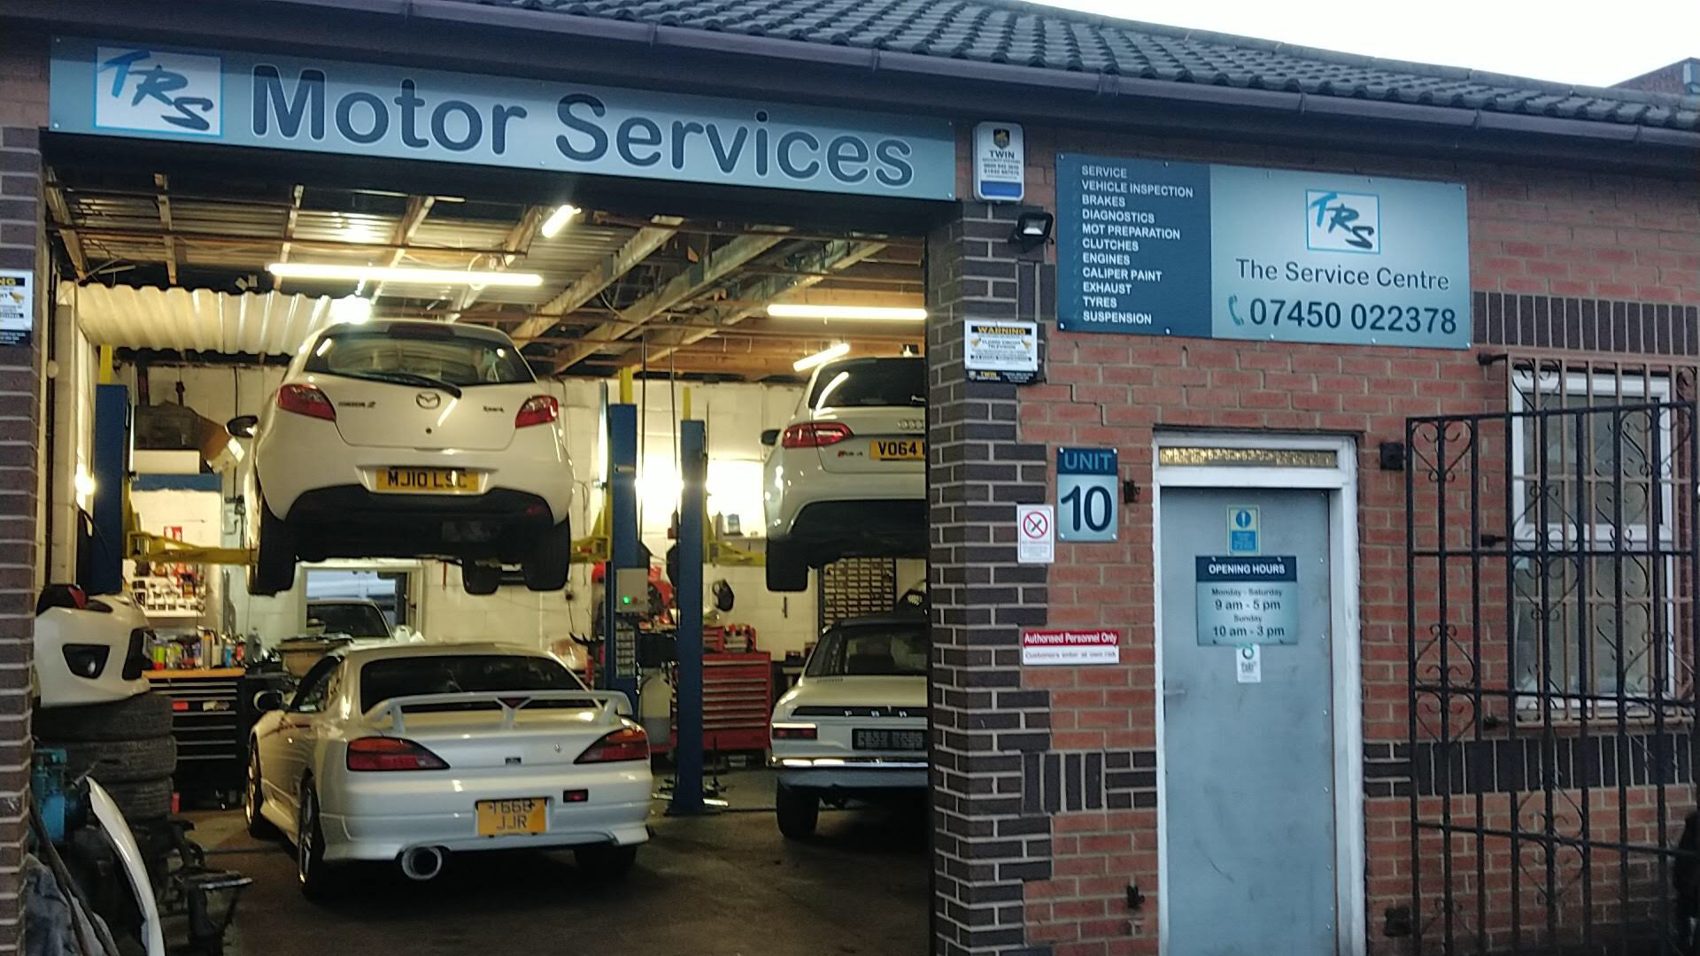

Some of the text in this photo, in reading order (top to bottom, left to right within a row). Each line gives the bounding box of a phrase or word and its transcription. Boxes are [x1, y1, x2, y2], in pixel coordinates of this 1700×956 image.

[102, 50, 214, 132] TRS
[252, 64, 913, 188] Motor Services
[989, 150, 1015, 159] TWIN
[1081, 165, 1128, 178] SERVICE
[1081, 179, 1194, 198] VEHICLE INSPECTION
[1082, 194, 1126, 207] BRAKES
[1082, 208, 1155, 224] DIAGNOSTICS
[1310, 192, 1375, 250] TRS
[1082, 223, 1181, 240] MOT PREPARATION
[1082, 238, 1139, 251] CLUTCHES
[1082, 252, 1131, 265] ENGINES
[1082, 267, 1163, 282] CALIPER PAINT
[1236, 258, 1450, 290] The Service Centre
[1083, 281, 1132, 295] EXHAUST
[1082, 296, 1118, 308] TYRES
[1083, 310, 1153, 325] SUSPENSION
[1250, 298, 1457, 335] 07450 022378
[977, 326, 1026, 335] WARNING
[1064, 452, 1113, 471] UNIT
[1060, 485, 1113, 532] 10
[1208, 563, 1286, 575] OPENING HOURS
[1211, 588, 1241, 597] Monday
[1248, 588, 1282, 597] Saturday
[1215, 599, 1222, 610] 9
[1225, 601, 1243, 610] am
[1253, 600, 1260, 610] 5
[1263, 601, 1281, 612] pm
[1233, 615, 1262, 623] Sunday
[1065, 632, 1100, 644] Personnel
[1101, 632, 1117, 645] Only
[1213, 626, 1226, 637] 10
[1229, 628, 1247, 637] am
[1257, 625, 1264, 637] 3
[1267, 628, 1285, 639] pm
